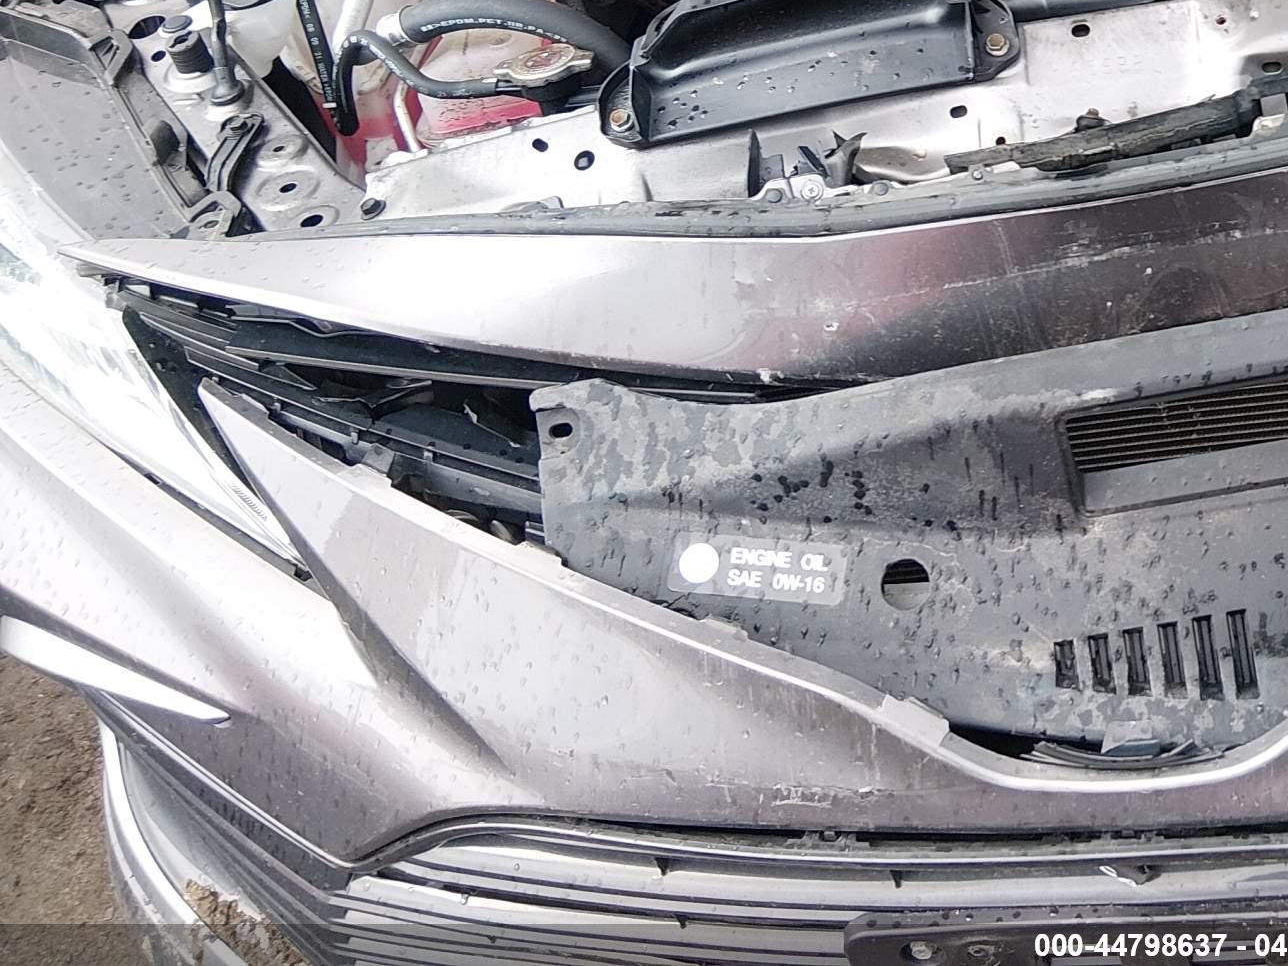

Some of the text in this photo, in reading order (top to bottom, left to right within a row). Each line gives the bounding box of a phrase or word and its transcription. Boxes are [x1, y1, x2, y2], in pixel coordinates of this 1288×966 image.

[730, 547, 829, 572] ENGINE OIL
[726, 568, 825, 594] SAE 0W-16
